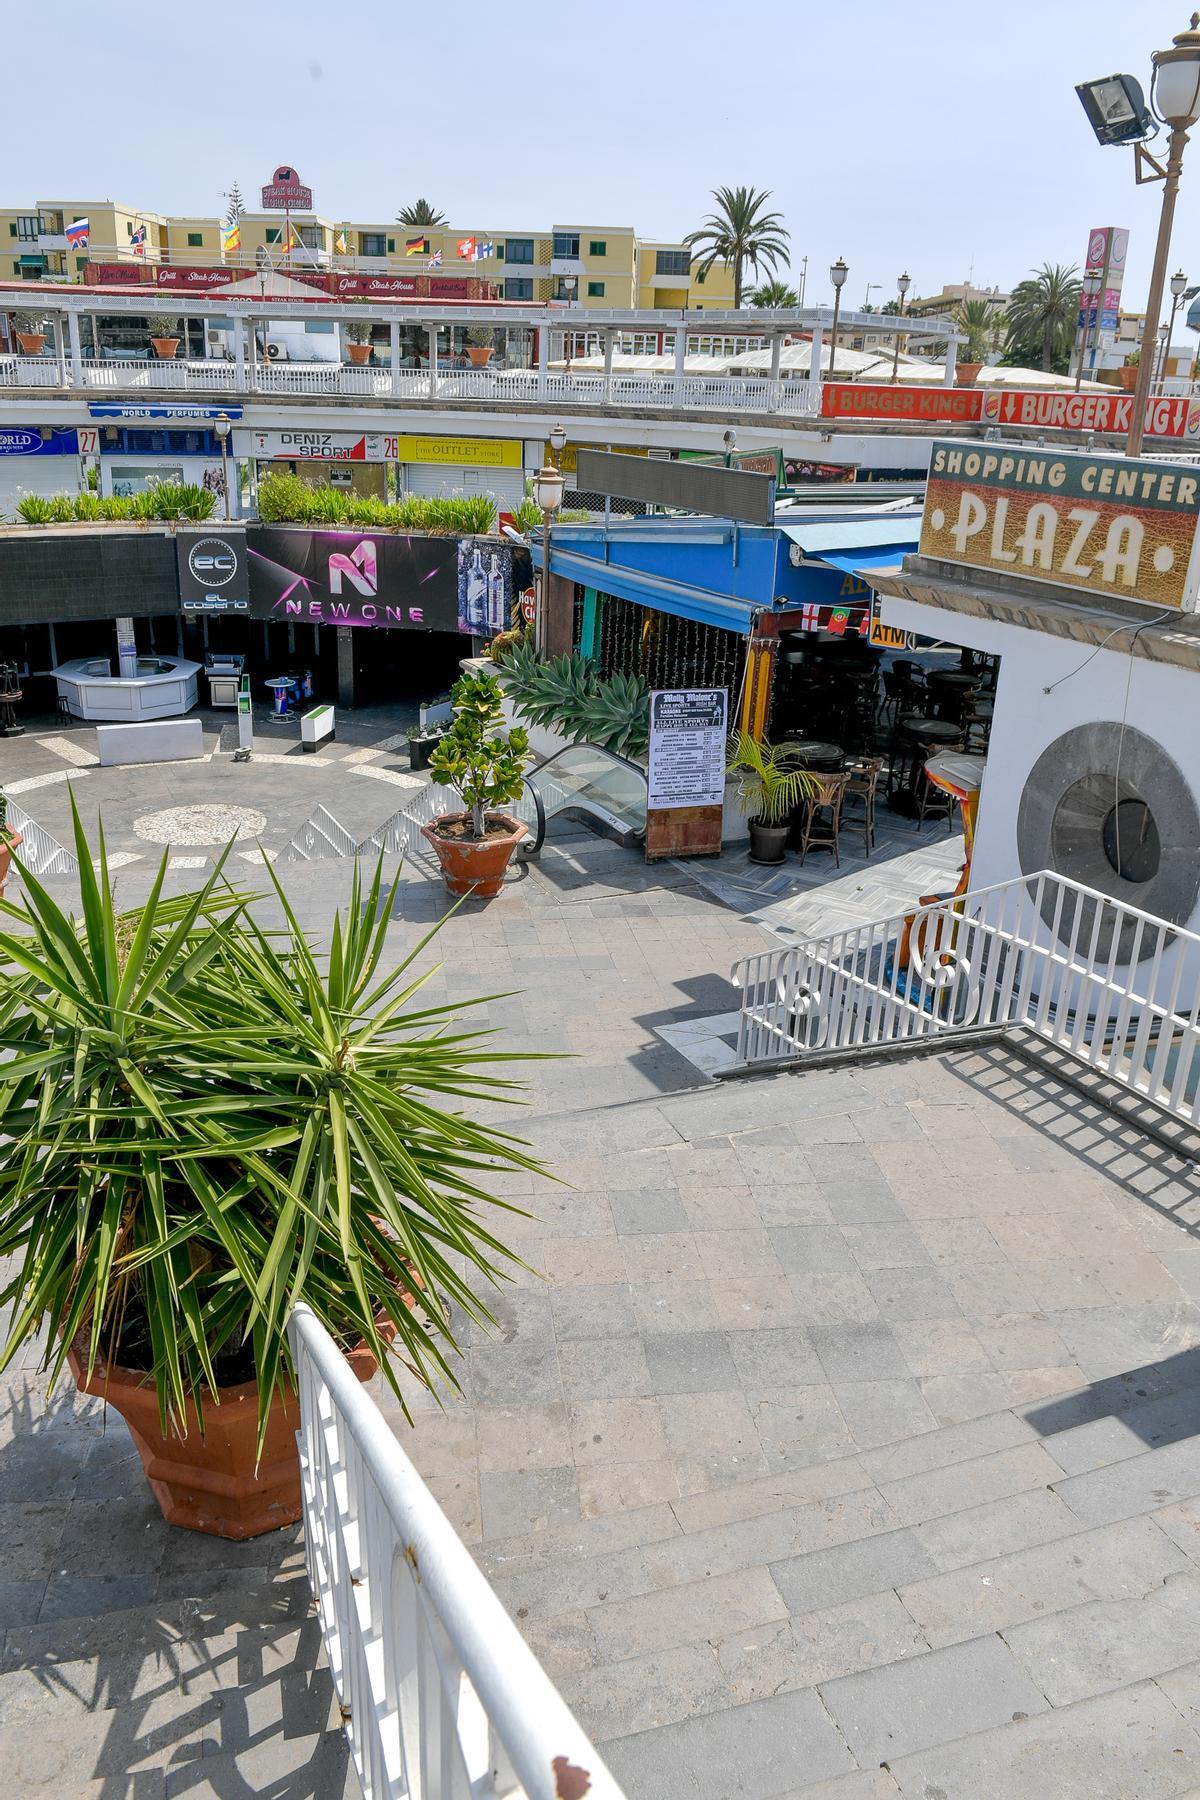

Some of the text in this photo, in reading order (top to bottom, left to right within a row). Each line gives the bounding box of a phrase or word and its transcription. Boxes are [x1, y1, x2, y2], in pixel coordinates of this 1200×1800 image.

[159, 270, 176, 282] Grill
[188, 271, 231, 282] Steak House
[339, 279, 357, 291] Grill
[369, 279, 414, 290] Steak House
[840, 390, 968, 416] BURGER KING
[121, 409, 211, 418] WORLD PERFUMES
[1021, 396, 1110, 429] BURGER
[1114, 399, 1171, 434] KNG
[80, 432, 97, 453] 27
[281, 433, 332, 446] DENIZ
[300, 446, 354, 458] SPORT
[384, 438, 398, 458] 26
[432, 445, 479, 457] OUTLET
[933, 450, 1198, 505] SHOPPING CENTER
[950, 490, 1145, 587] PLAZA
[285, 599, 424, 623] NEW ONE
[872, 624, 906, 645] ATM
[663, 694, 685, 703] Molly
